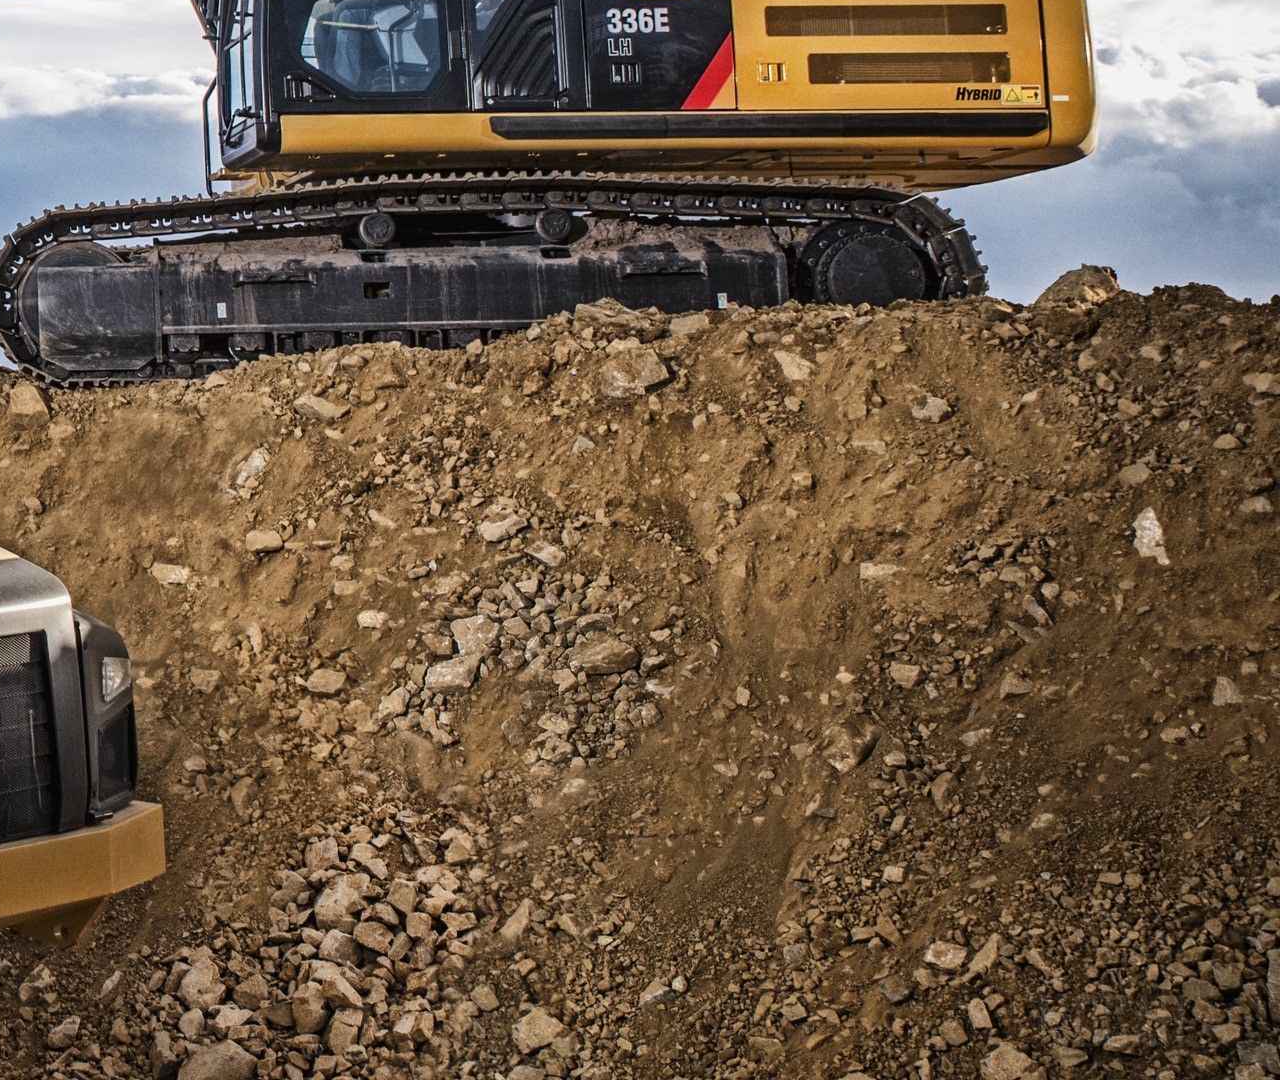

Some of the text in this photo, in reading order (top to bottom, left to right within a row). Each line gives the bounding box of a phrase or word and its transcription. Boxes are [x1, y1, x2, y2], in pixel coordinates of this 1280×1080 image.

[606, 8, 670, 34] 336E
[607, 38, 633, 57] LH
[956, 87, 1001, 101] HYBRID
